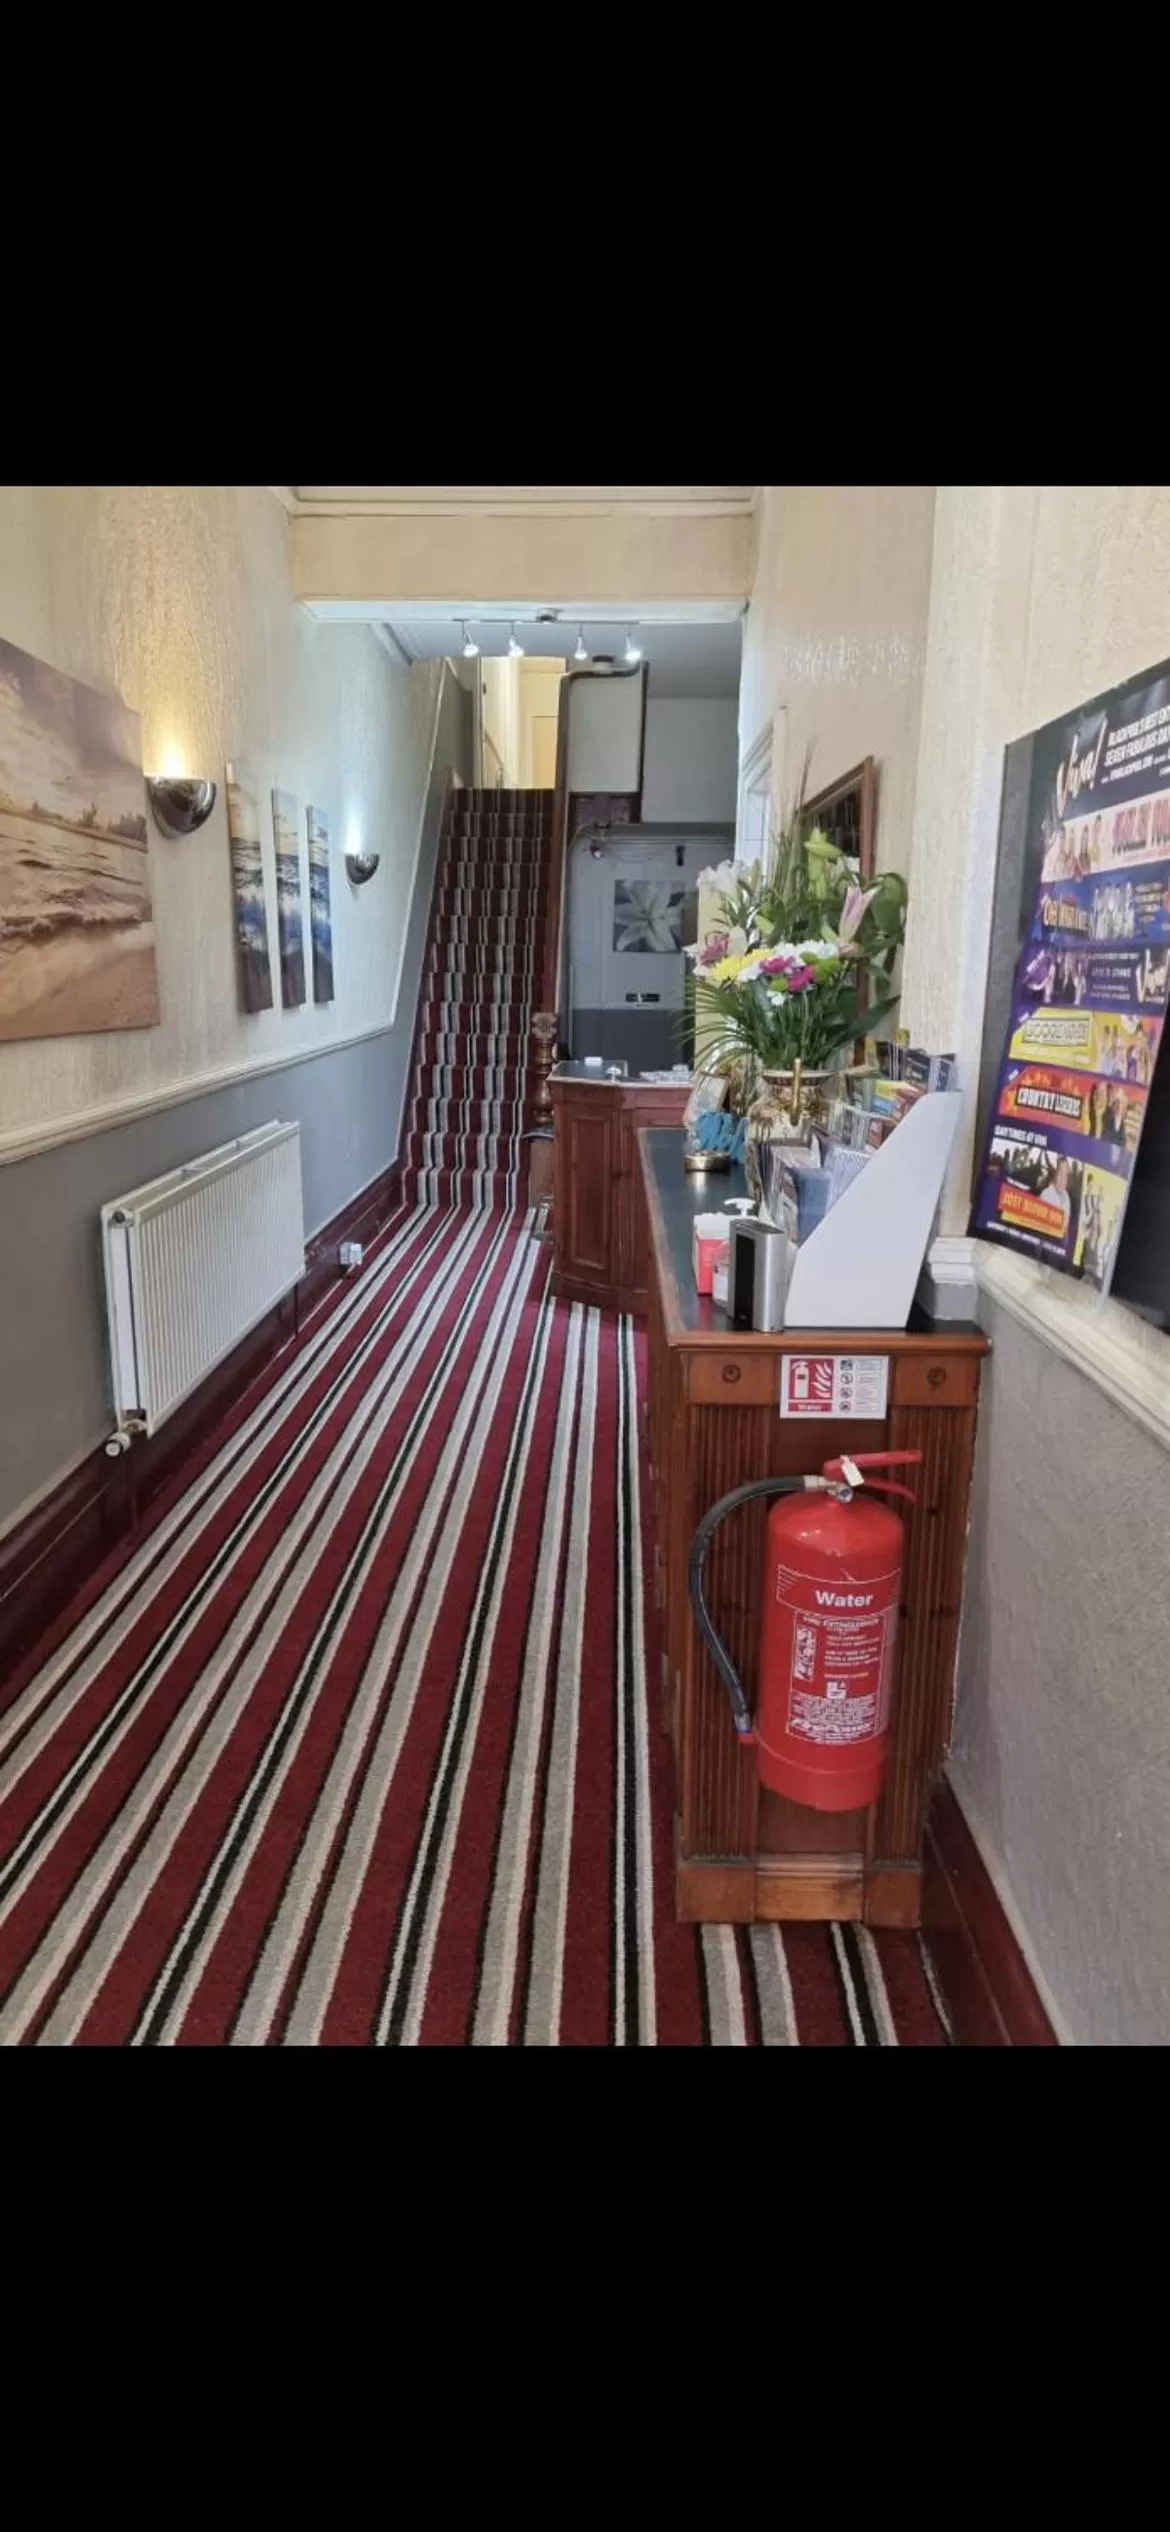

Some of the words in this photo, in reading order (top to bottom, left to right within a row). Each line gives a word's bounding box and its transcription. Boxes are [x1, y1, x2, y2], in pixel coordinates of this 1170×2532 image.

[1056, 712, 1108, 818] Viva!
[1017, 1087, 1057, 1112] COUNTRY
[815, 1589, 874, 1608] Water
